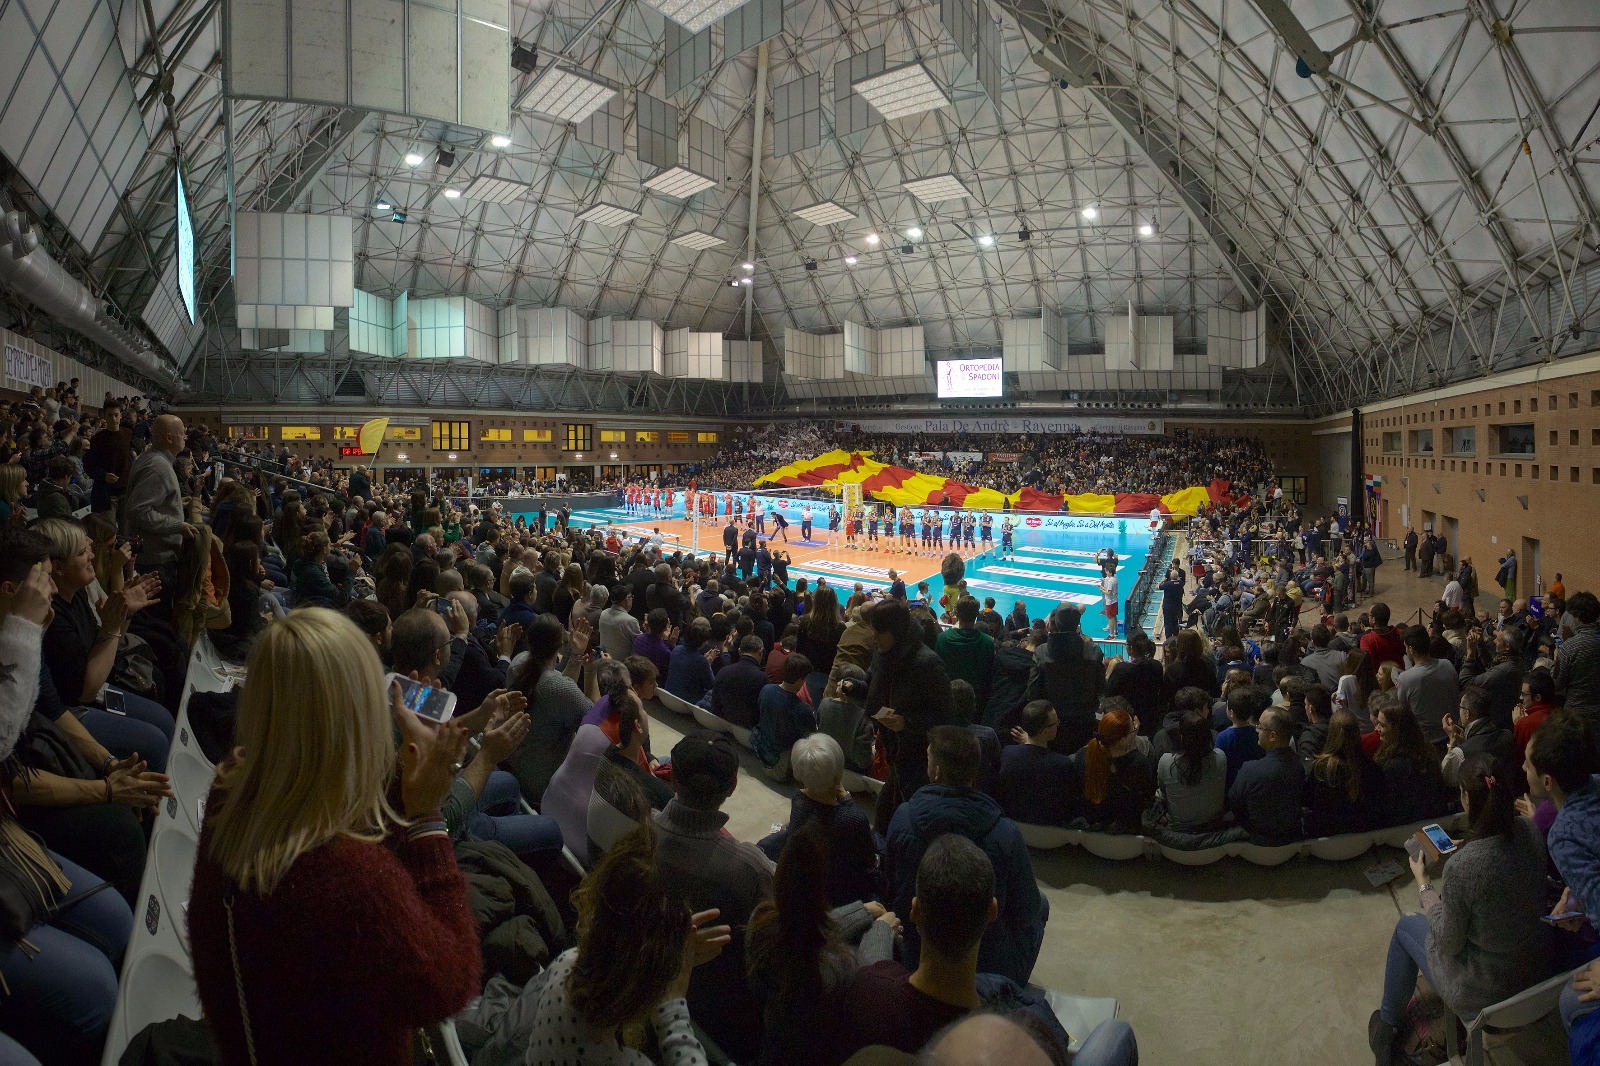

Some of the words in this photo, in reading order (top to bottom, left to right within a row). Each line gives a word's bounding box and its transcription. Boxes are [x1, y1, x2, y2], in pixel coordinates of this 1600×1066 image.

[959, 363, 1000, 372] ORTOPEDIA
[968, 372, 1000, 381] SPADONI
[924, 420, 949, 432] Pala
[952, 420, 969, 432] De
[972, 420, 1009, 432] Andrè
[1022, 420, 1078, 433] Ravenna
